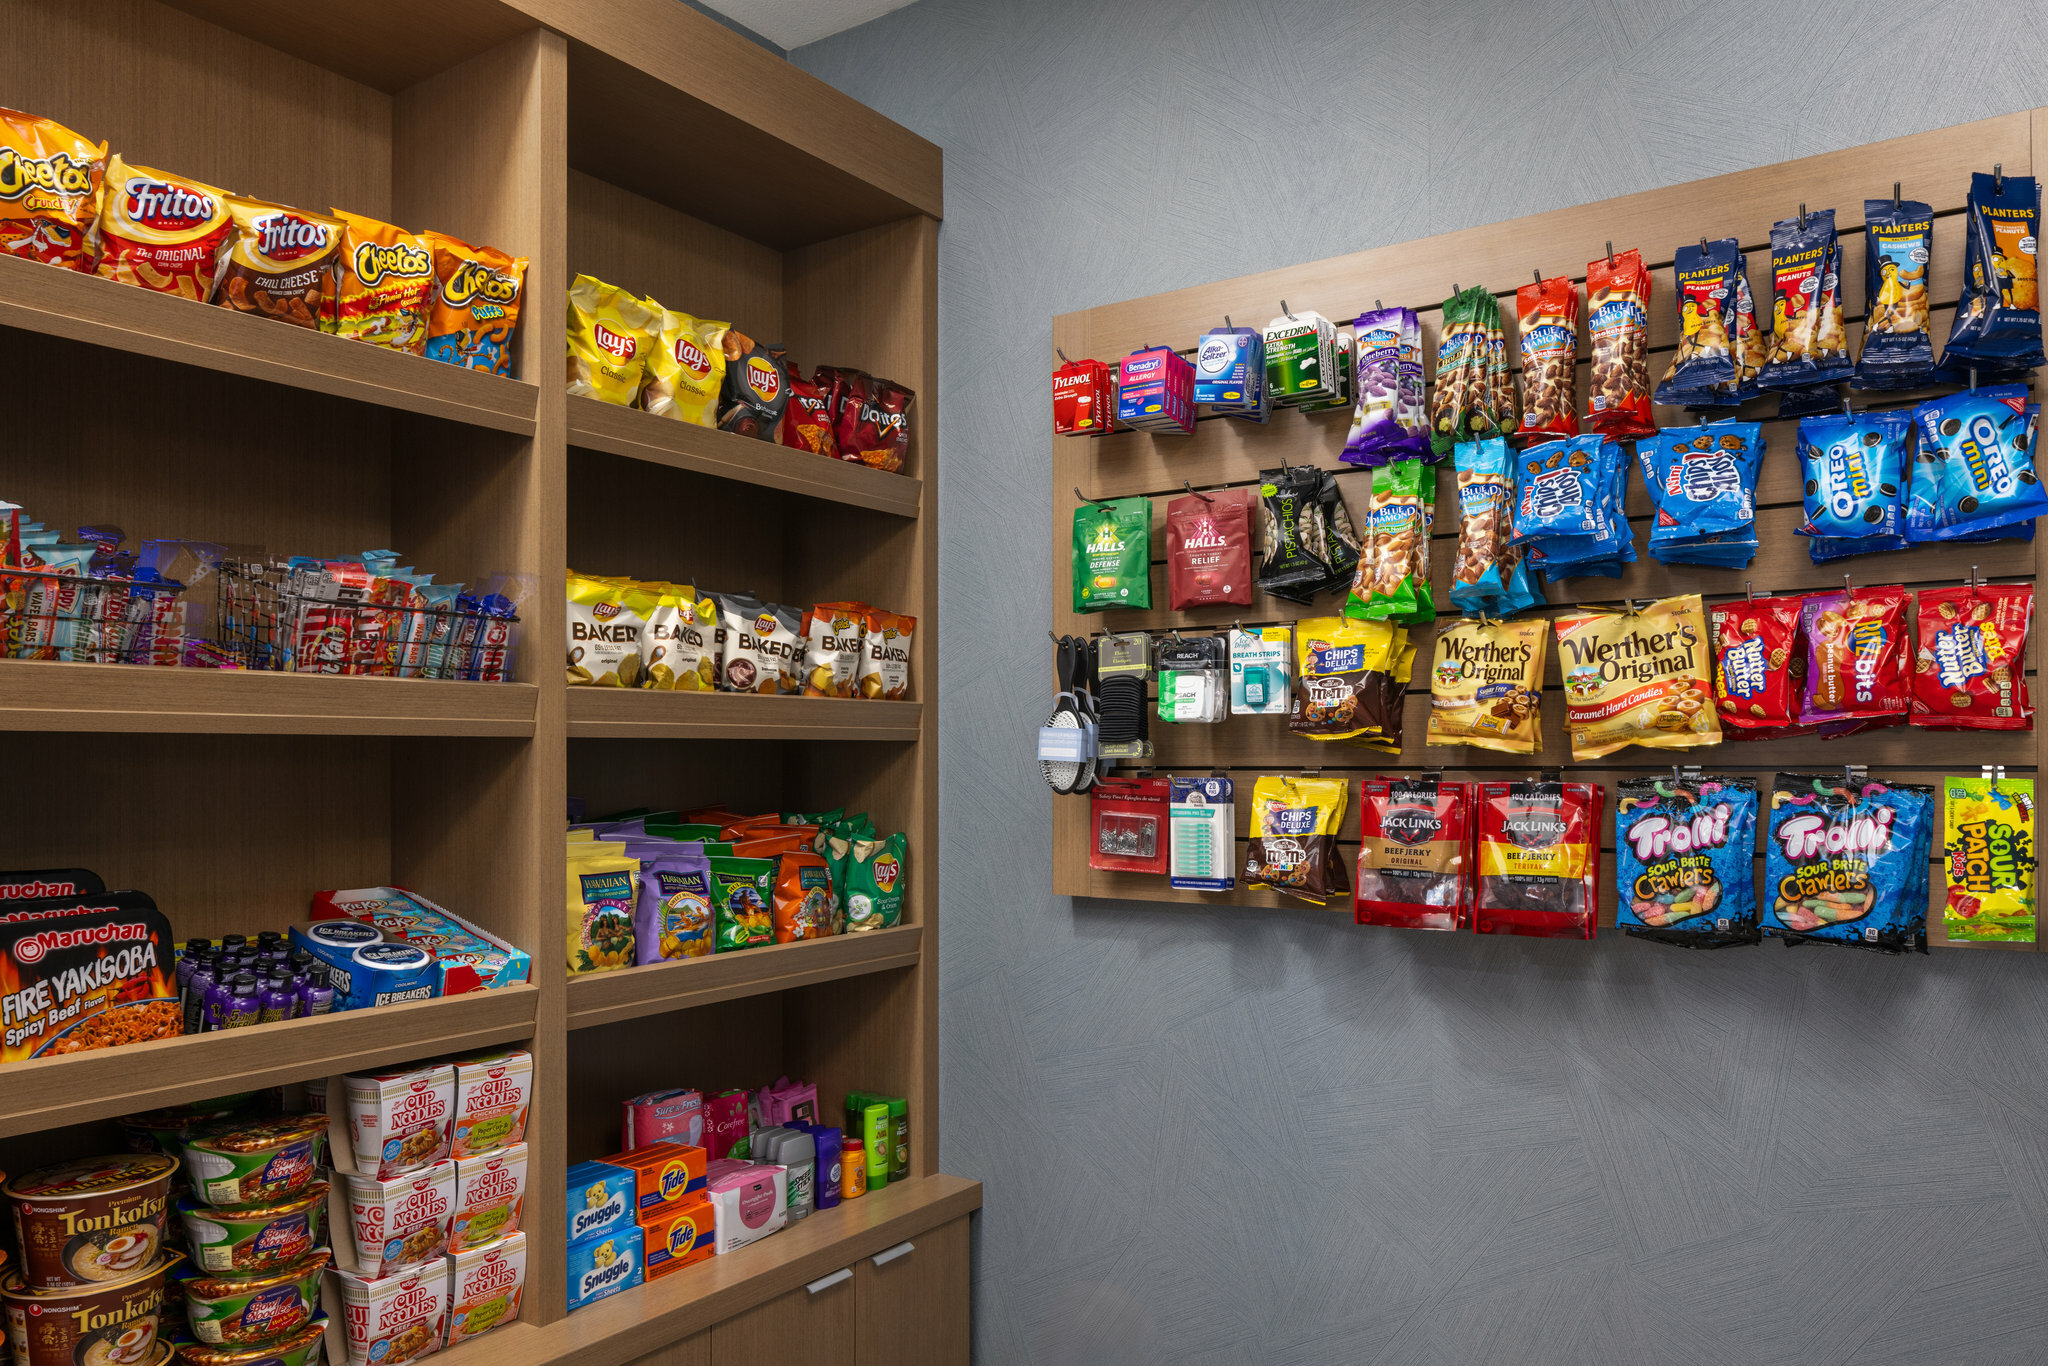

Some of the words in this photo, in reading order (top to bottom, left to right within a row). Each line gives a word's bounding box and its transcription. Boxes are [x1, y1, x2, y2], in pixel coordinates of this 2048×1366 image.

[0, 149, 91, 195] Cheetos
[24, 195, 77, 211] Crunchy
[126, 177, 214, 222] Fritos
[1981, 205, 2035, 219] PLANTERS
[252, 213, 327, 255] Fritos
[1872, 222, 1930, 235] PLANTERS
[137, 247, 152, 259] The
[155, 247, 206, 262] ORIGINAL
[1881, 241, 1921, 249] CASHEWS
[355, 243, 430, 285] Cheetos
[1772, 246, 1824, 268] PLANTERS
[255, 276, 279, 289] CHILI
[280, 270, 319, 289] CHEESE
[1678, 264, 1730, 282] PLANTERS
[1777, 270, 1812, 283] PEANUTS
[404, 287, 420, 296] Hot
[1686, 283, 1720, 291] PEANUTS
[472, 305, 504, 320] Puffs
[1588, 305, 1636, 332] DIAMOND
[1598, 301, 1625, 317] BLUE
[597, 324, 635, 357] Lay's
[1266, 324, 1315, 342] EXCEDRIN
[1361, 333, 1396, 343] DIAMOND
[1520, 329, 1566, 351] DIAMOND
[1530, 327, 1556, 340] BLUE
[677, 340, 710, 371] Lay's
[1128, 359, 1160, 371] Benadryl
[1201, 351, 1227, 361] Seltzer
[1361, 348, 1396, 366] Blueberry
[600, 365, 627, 383] Classic
[749, 365, 778, 392] Lay's
[1054, 373, 1091, 390] TYLENOL
[1128, 372, 1156, 382] ALLERGY
[679, 380, 706, 397] Classic
[861, 403, 907, 427] Doritos
[1961, 439, 1991, 491] mini
[1972, 417, 2012, 494] OREO
[1666, 466, 1684, 497] Mini
[1685, 460, 1719, 501] Chips
[1830, 444, 1855, 517] OREO
[1848, 452, 1870, 497] mini
[1461, 485, 1486, 497] BLUE
[1536, 478, 1563, 518] Chips
[1520, 486, 1535, 517] Mini
[1372, 507, 1416, 526] DIAMOND
[1380, 507, 1404, 516] BLUE
[1282, 498, 1297, 559] PISTACHIOS
[1086, 541, 1125, 553] HALLS
[1184, 536, 1227, 549] HALLS
[1089, 560, 1120, 569] DEFENSE
[1191, 556, 1220, 565] RELIEF
[595, 603, 619, 618] Lay's
[572, 622, 638, 643] BAKED
[756, 619, 777, 631] Lay's
[1557, 620, 1582, 640] Caramel
[654, 625, 703, 647] BAKED
[1563, 622, 1697, 665] Werther's
[1856, 620, 1882, 657] RITZ
[1980, 621, 2006, 662] Bites
[739, 633, 793, 659] BAKED
[871, 645, 908, 663] BAKED
[1325, 648, 1359, 661] CHIPS
[1441, 636, 1532, 663] Werther's
[1952, 625, 1984, 678] Butter
[1325, 657, 1358, 668] DELUXE
[1599, 647, 1695, 683] Original
[1745, 638, 1766, 692] Nutter
[1825, 643, 1834, 673] peanut
[1935, 631, 1965, 688] Nutter
[1461, 660, 1525, 684] Original
[1727, 648, 1751, 699] Butter
[1855, 659, 1877, 703] bits
[1479, 687, 1495, 696] Sugar
[1496, 685, 1508, 693] Free
[1828, 674, 1836, 703] butter
[1569, 707, 1605, 720] Caramel
[1605, 699, 1627, 715] Hard
[1628, 687, 1664, 704] Candies
[1511, 793, 1524, 801] 100
[1525, 793, 1562, 801] CALORIES
[1280, 820, 1311, 829] DELUXE
[1281, 811, 1312, 821] CHIPS
[1380, 816, 1408, 829] JACK
[1408, 817, 1442, 830] LINK'S
[1501, 820, 1529, 833] JACK
[1530, 821, 1567, 833] LINK'S
[1629, 804, 1731, 860] Trolli
[1779, 807, 1893, 860] Trolli
[1384, 847, 1404, 855] BEEF
[1404, 848, 1431, 857] JERKY
[1390, 857, 1423, 865] ORIGINAL
[1506, 852, 1526, 860] BEEF
[1526, 853, 1556, 861] JERKY
[1962, 821, 1991, 892] PATCH
[1988, 824, 2017, 888] SOUR
[874, 862, 899, 884] Lay's
[1647, 859, 1677, 877] SOUR
[1796, 863, 1828, 878] SOUR
[1952, 851, 1966, 877] Kids
[584, 876, 628, 890] HAWAIIAN
[661, 874, 703, 885] HAWAIIAN
[1634, 867, 1713, 900] Crawlers
[1780, 871, 1868, 902] Crawlers
[594, 899, 628, 914] ORIGINAL
[35, 923, 147, 950] Maruchan
[319, 927, 335, 935] ICE
[363, 951, 380, 960] ICE
[3, 979, 51, 1026] FIRE
[52, 941, 157, 1003] YAKISOBA
[375, 992, 391, 1008] ICE
[391, 985, 432, 1003] BREAKERS
[5, 1018, 46, 1047] Spicy
[48, 998, 82, 1027] Beef
[84, 995, 106, 1011] Flavor
[481, 1078, 512, 1096] CUP
[405, 1091, 435, 1111] CUP
[466, 1088, 521, 1112] NOODLES
[654, 1105, 674, 1118] Sure
[682, 1096, 701, 1110] Fresh
[391, 1101, 445, 1131] NOODLES
[472, 1108, 501, 1118] CHICKEN
[405, 1124, 421, 1135] BEEF
[717, 1117, 745, 1133] Carefree
[478, 1168, 509, 1187] CUP
[662, 1169, 686, 1196] Tide
[108, 1195, 142, 1207] Premium
[465, 1178, 517, 1206] NOODLES
[58, 1195, 166, 1237] Tonkotsu
[393, 1201, 447, 1230] NOODLES
[575, 1201, 621, 1234] Snuggle
[109, 1223, 139, 1236] Ramen
[264, 1225, 292, 1238] Bowl
[595, 1226, 613, 1237] Sheets
[259, 1232, 301, 1249] Noodles
[669, 1226, 694, 1253] Tide
[476, 1260, 507, 1280] CUP
[584, 1261, 629, 1293] Snuggle
[463, 1270, 516, 1299] NOODLES
[603, 1284, 621, 1296] Sheets
[250, 1297, 280, 1313] Bowl
[393, 1287, 427, 1309] CUP
[43, 1305, 80, 1313] NONGSHIM
[246, 1304, 292, 1323] Noodles
[379, 1296, 437, 1331] NOODLES
[393, 1323, 411, 1335] BEEF
